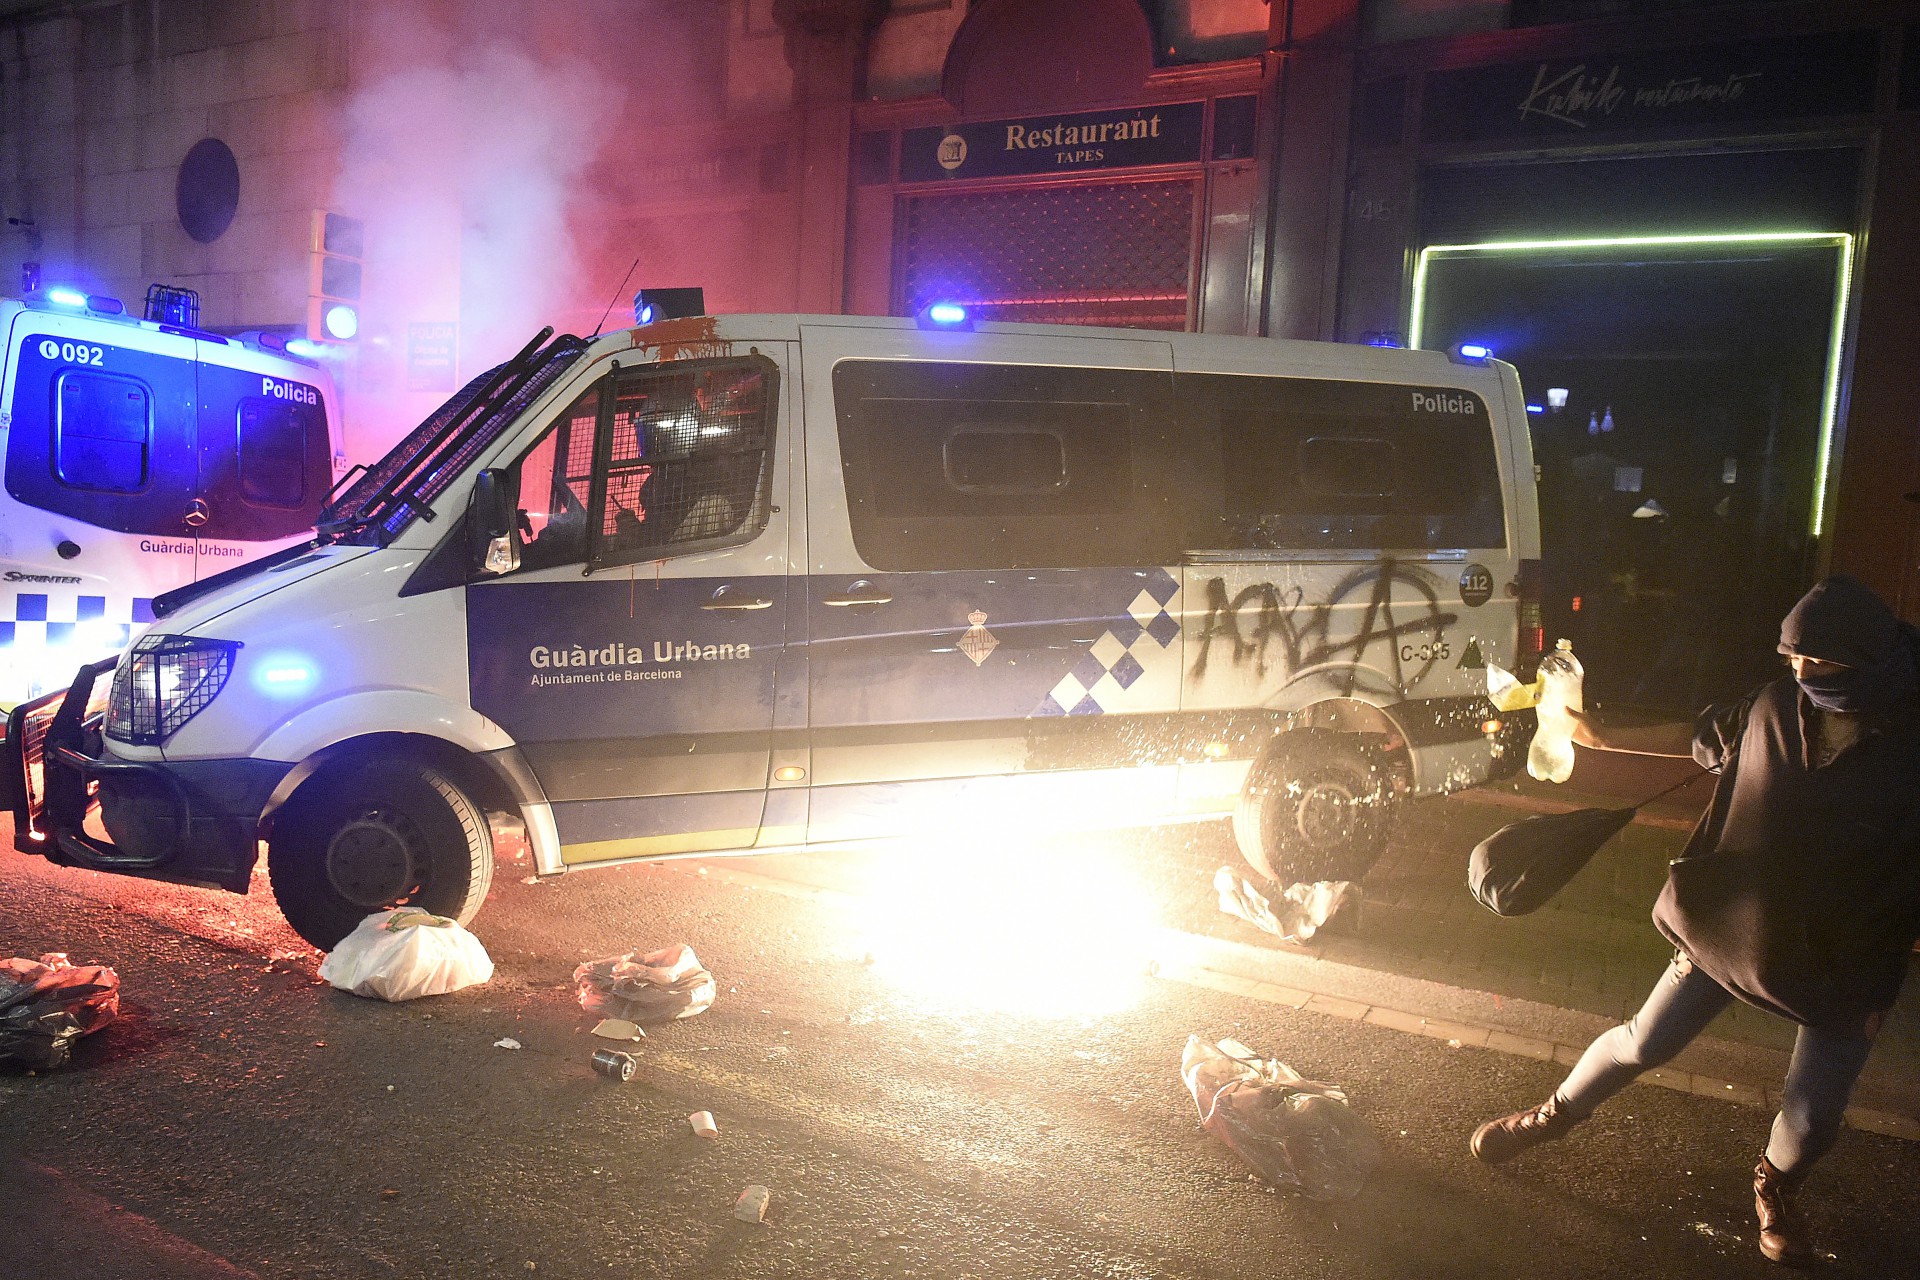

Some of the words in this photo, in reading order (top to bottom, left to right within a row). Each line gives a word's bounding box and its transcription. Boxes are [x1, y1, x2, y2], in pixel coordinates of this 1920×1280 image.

[1005, 113, 1161, 150] Restaurant
[1055, 149, 1104, 164] TAPES
[61, 344, 104, 367] 092
[262, 377, 317, 406] Policia
[1412, 392, 1475, 415] Policia
[140, 540, 194, 555] Guàrdia
[199, 543, 244, 557] Urbana
[1465, 575, 1488, 590] 112
[530, 643, 643, 668] Guàrdia
[653, 641, 750, 663] Urbana
[531, 672, 604, 687] Ajuntament
[607, 671, 621, 682] de
[624, 669, 682, 681] Barcelona
